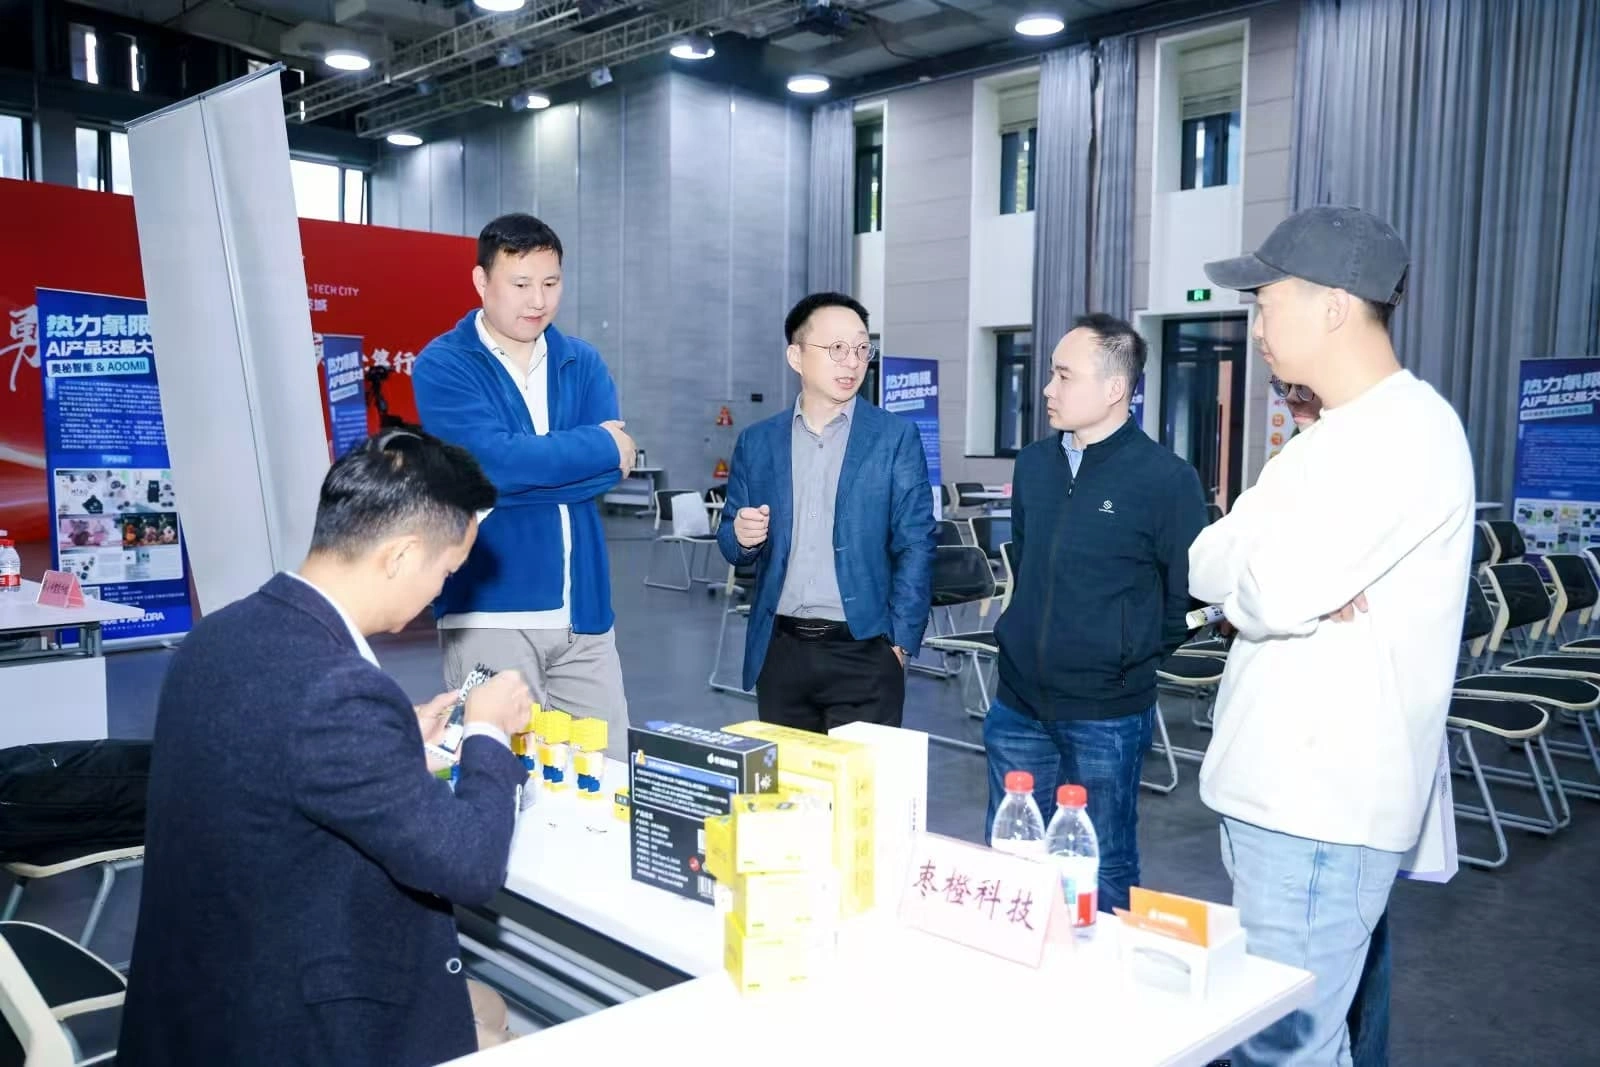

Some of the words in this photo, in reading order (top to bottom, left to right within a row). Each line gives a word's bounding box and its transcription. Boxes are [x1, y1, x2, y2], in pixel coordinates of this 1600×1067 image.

[338, 285, 360, 297] CITY
[46, 314, 151, 338] 热力象限
[96, 362, 105, 372] &
[912, 859, 1035, 931] 枣橙科技
